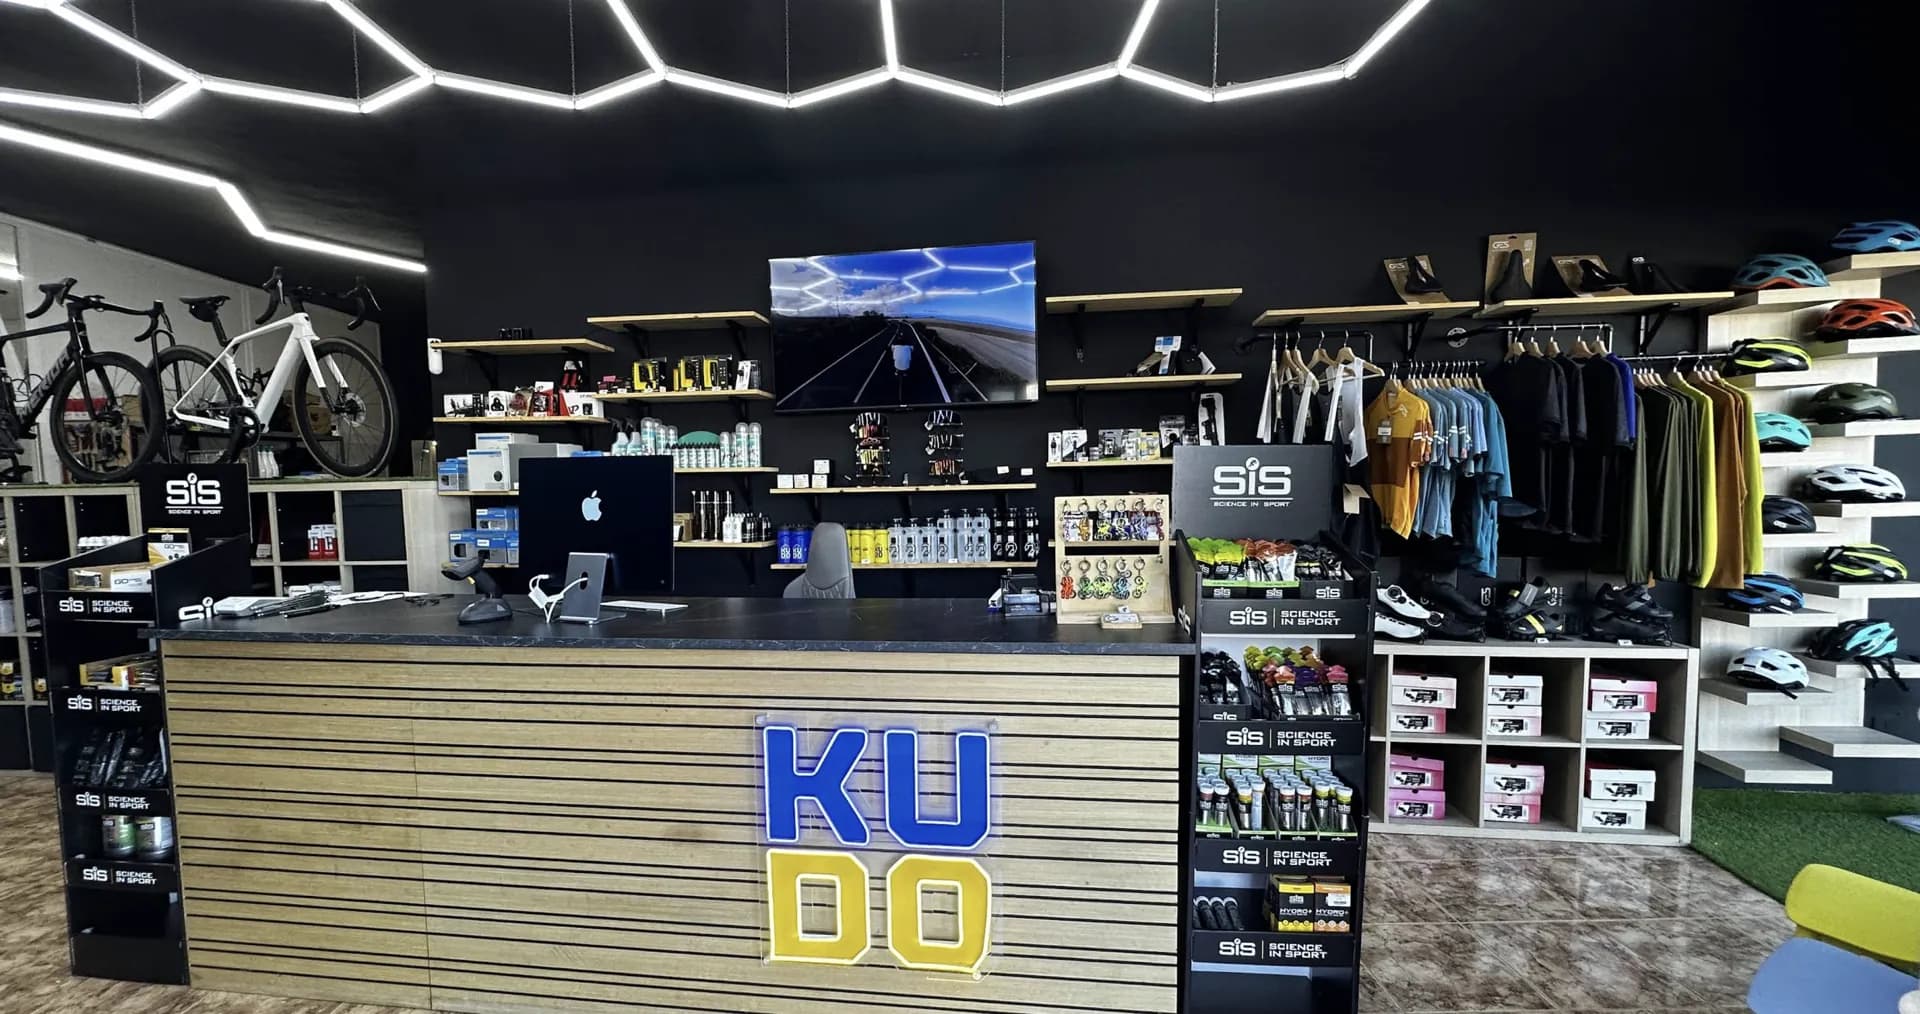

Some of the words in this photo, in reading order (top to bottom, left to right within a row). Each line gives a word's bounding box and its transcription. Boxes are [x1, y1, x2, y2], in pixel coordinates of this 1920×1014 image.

[1212, 456, 1292, 496] SiS
[166, 472, 221, 505] SiS
[1315, 586, 1341, 598] SiS
[59, 596, 84, 612] SiS
[1229, 606, 1267, 626] SiS
[1280, 610, 1336, 618] SCIENCE
[1280, 618, 1294, 626] IN
[1297, 618, 1341, 626] SPORT
[67, 694, 92, 710] SiS
[100, 698, 138, 706] SCIENCE
[1226, 727, 1264, 746] SiS
[1277, 731, 1332, 739] SCIENCE
[1293, 739, 1337, 747] SPORT
[763, 726, 990, 850] KU
[75, 791, 101, 807] SiS
[108, 795, 146, 803] SCIENCE
[1222, 846, 1261, 865] SiS
[1273, 851, 1328, 859] SCIENCE
[1273, 858, 1287, 866] IN
[1290, 859, 1333, 867] SPORT
[82, 866, 108, 882] SiS
[115, 870, 154, 878] SCIENCE
[766, 848, 991, 972] DO
[1219, 938, 1257, 956] SiS
[1268, 943, 1323, 951] SCIENCE
[1285, 951, 1328, 959] SPORT
